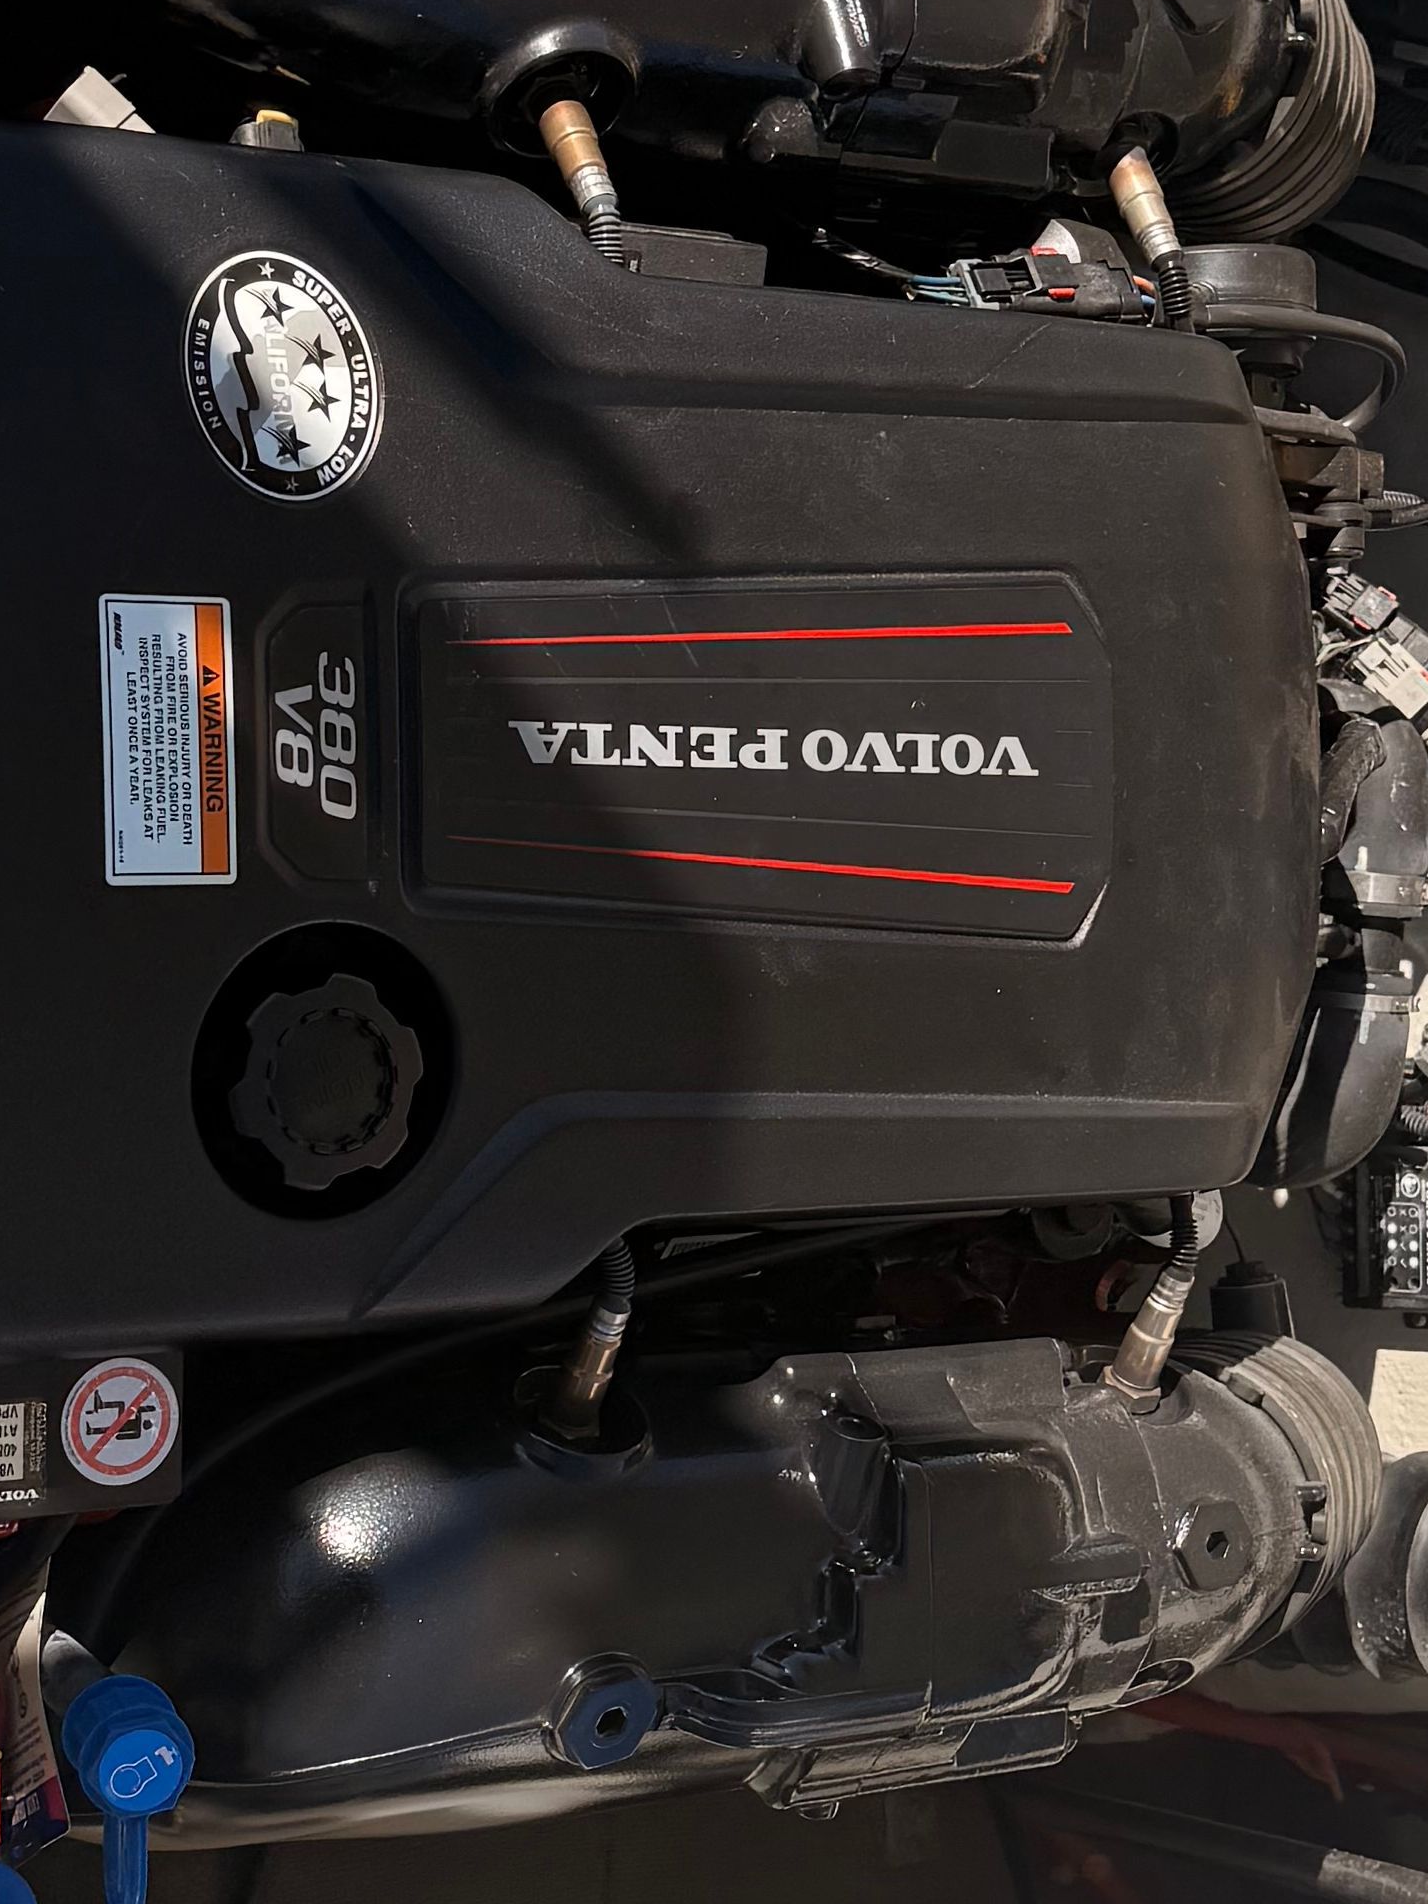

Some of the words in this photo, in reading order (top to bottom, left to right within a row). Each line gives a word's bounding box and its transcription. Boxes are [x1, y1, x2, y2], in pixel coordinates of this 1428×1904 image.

[291, 270, 353, 336] SUPER
[193, 318, 223, 429] EMISSION
[350, 354, 369, 429] ULTRA
[316, 445, 355, 487] LOW
[138, 637, 150, 691] INSPECT
[151, 634, 163, 705] RESULTING
[177, 633, 189, 671] AVOID
[126, 671, 138, 712] LEAST
[165, 656, 176, 692] FROM
[140, 694, 151, 746] SYSTEM
[167, 696, 177, 725] FIRE
[178, 674, 190, 731] SERIOUS
[128, 716, 138, 752] ONCE
[154, 708, 164, 745] FROM
[167, 727, 177, 746] OR
[273, 684, 315, 789] V8
[317, 651, 358, 822] 380
[508, 720, 789, 770] PENTA
[129, 755, 139, 764] A
[142, 749, 152, 776] FOR
[179, 734, 190, 778] INJURY
[204, 693, 224, 813] WARNING
[802, 728, 1040, 777] VOLVO
[129, 767, 141, 805] YEAR.
[154, 748, 165, 804] LEAKING
[168, 749, 179, 822] EXPLOSION
[181, 782, 191, 801] OR
[143, 779, 153, 821] LEAKS
[144, 824, 154, 840] AT
[156, 807, 167, 843] FUEL.
[182, 803, 192, 845] DEATH
